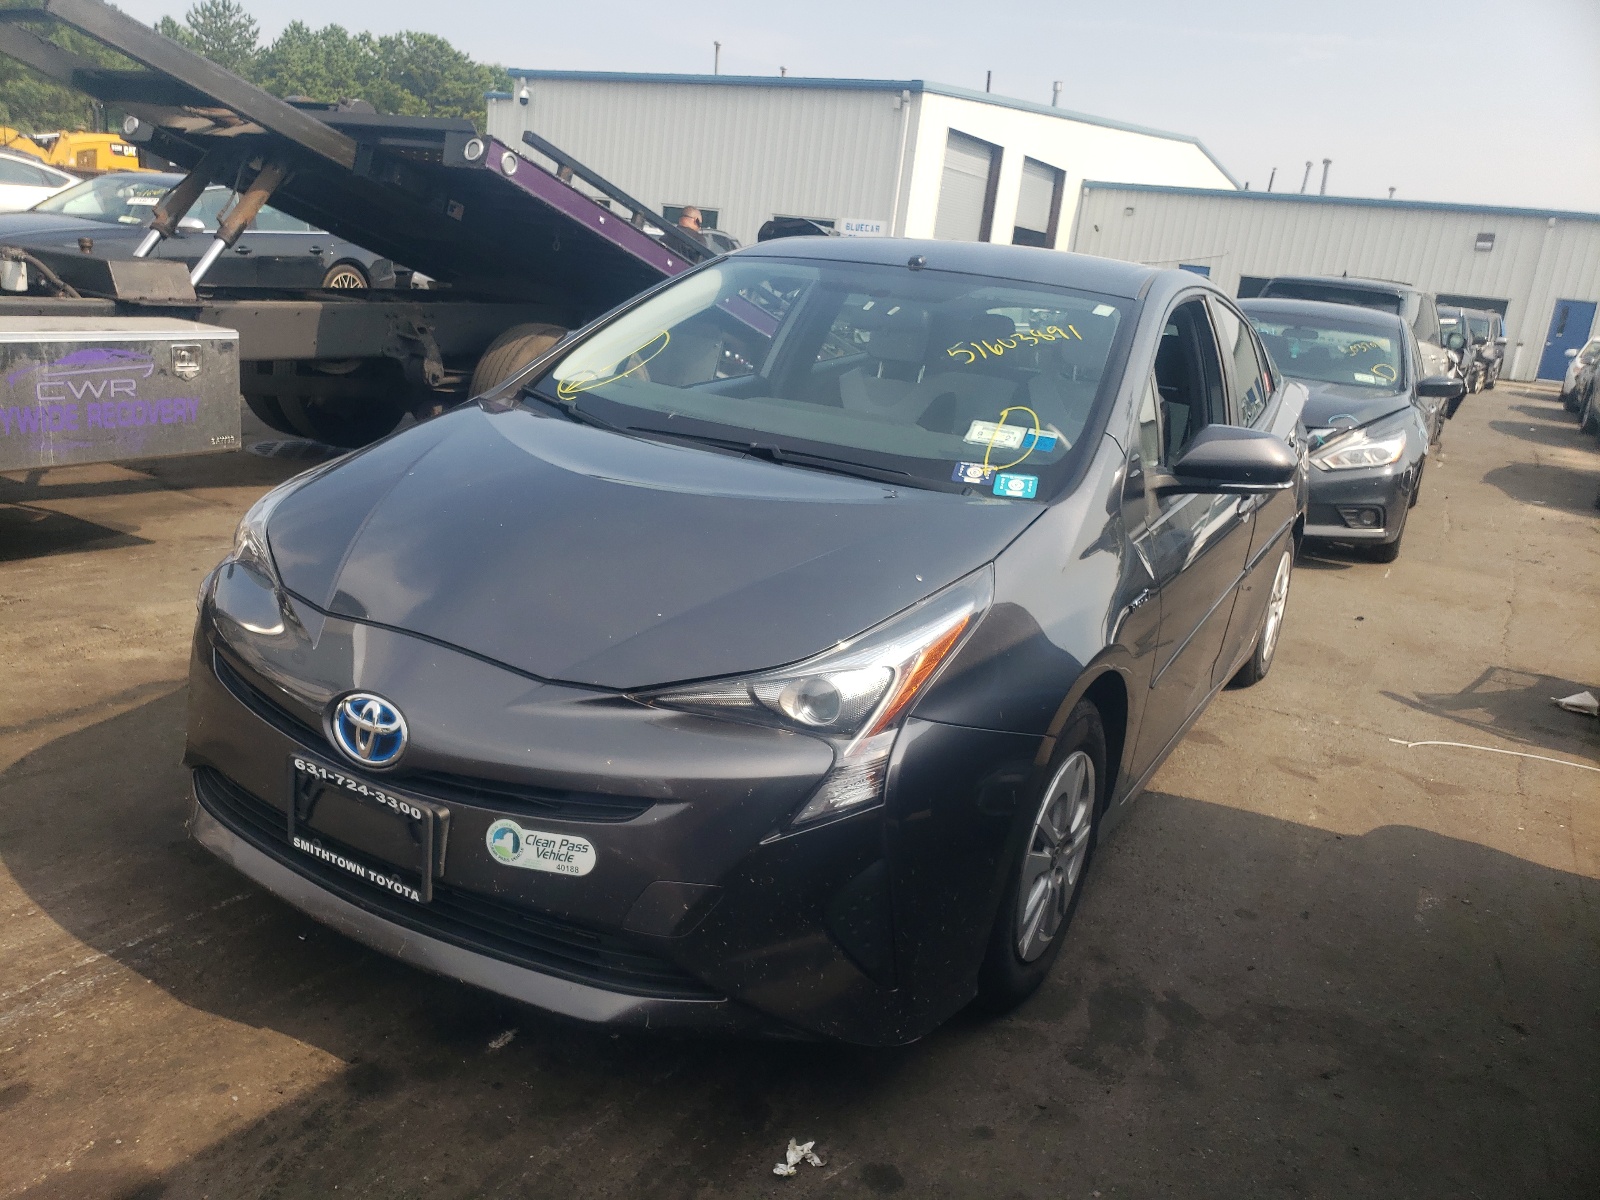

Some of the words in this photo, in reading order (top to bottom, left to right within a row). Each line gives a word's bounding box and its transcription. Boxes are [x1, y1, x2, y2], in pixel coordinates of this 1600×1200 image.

[846, 222, 880, 232] BLUECAR
[36, 378, 137, 400] CWR
[87, 397, 200, 429] RECOVERY
[294, 758, 421, 820] 631-724-3300
[525, 834, 556, 849] Clean
[558, 838, 589, 853] Pass
[536, 846, 575, 863] Vehicle
[293, 837, 365, 877] SMITHTOWN
[368, 870, 420, 902] TOYOTA
[556, 863, 579, 873] 40188
